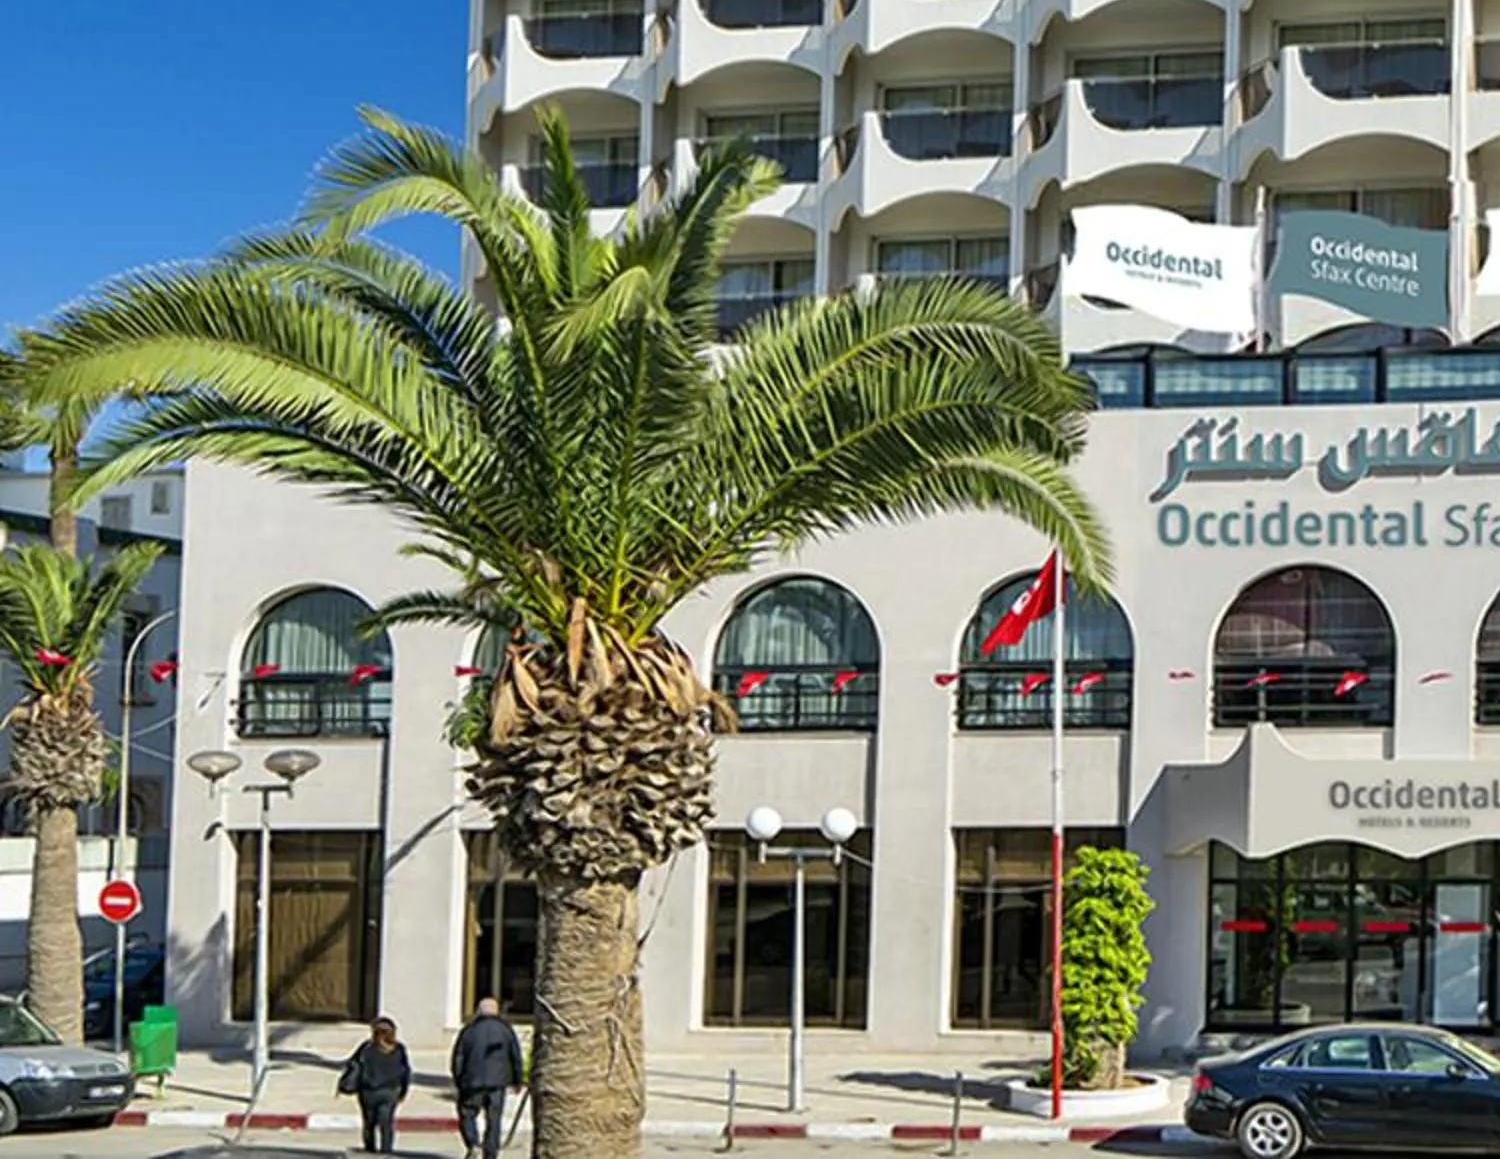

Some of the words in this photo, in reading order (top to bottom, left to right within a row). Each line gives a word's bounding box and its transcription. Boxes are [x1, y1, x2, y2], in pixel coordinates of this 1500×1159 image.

[1106, 240, 1223, 281] Occidental
[1310, 235, 1419, 272] Occidental
[1310, 258, 1353, 284] Sfax
[1354, 266, 1420, 297] Centre
[1149, 416, 1304, 503] سنتر
[1156, 500, 1429, 548] Occidental
